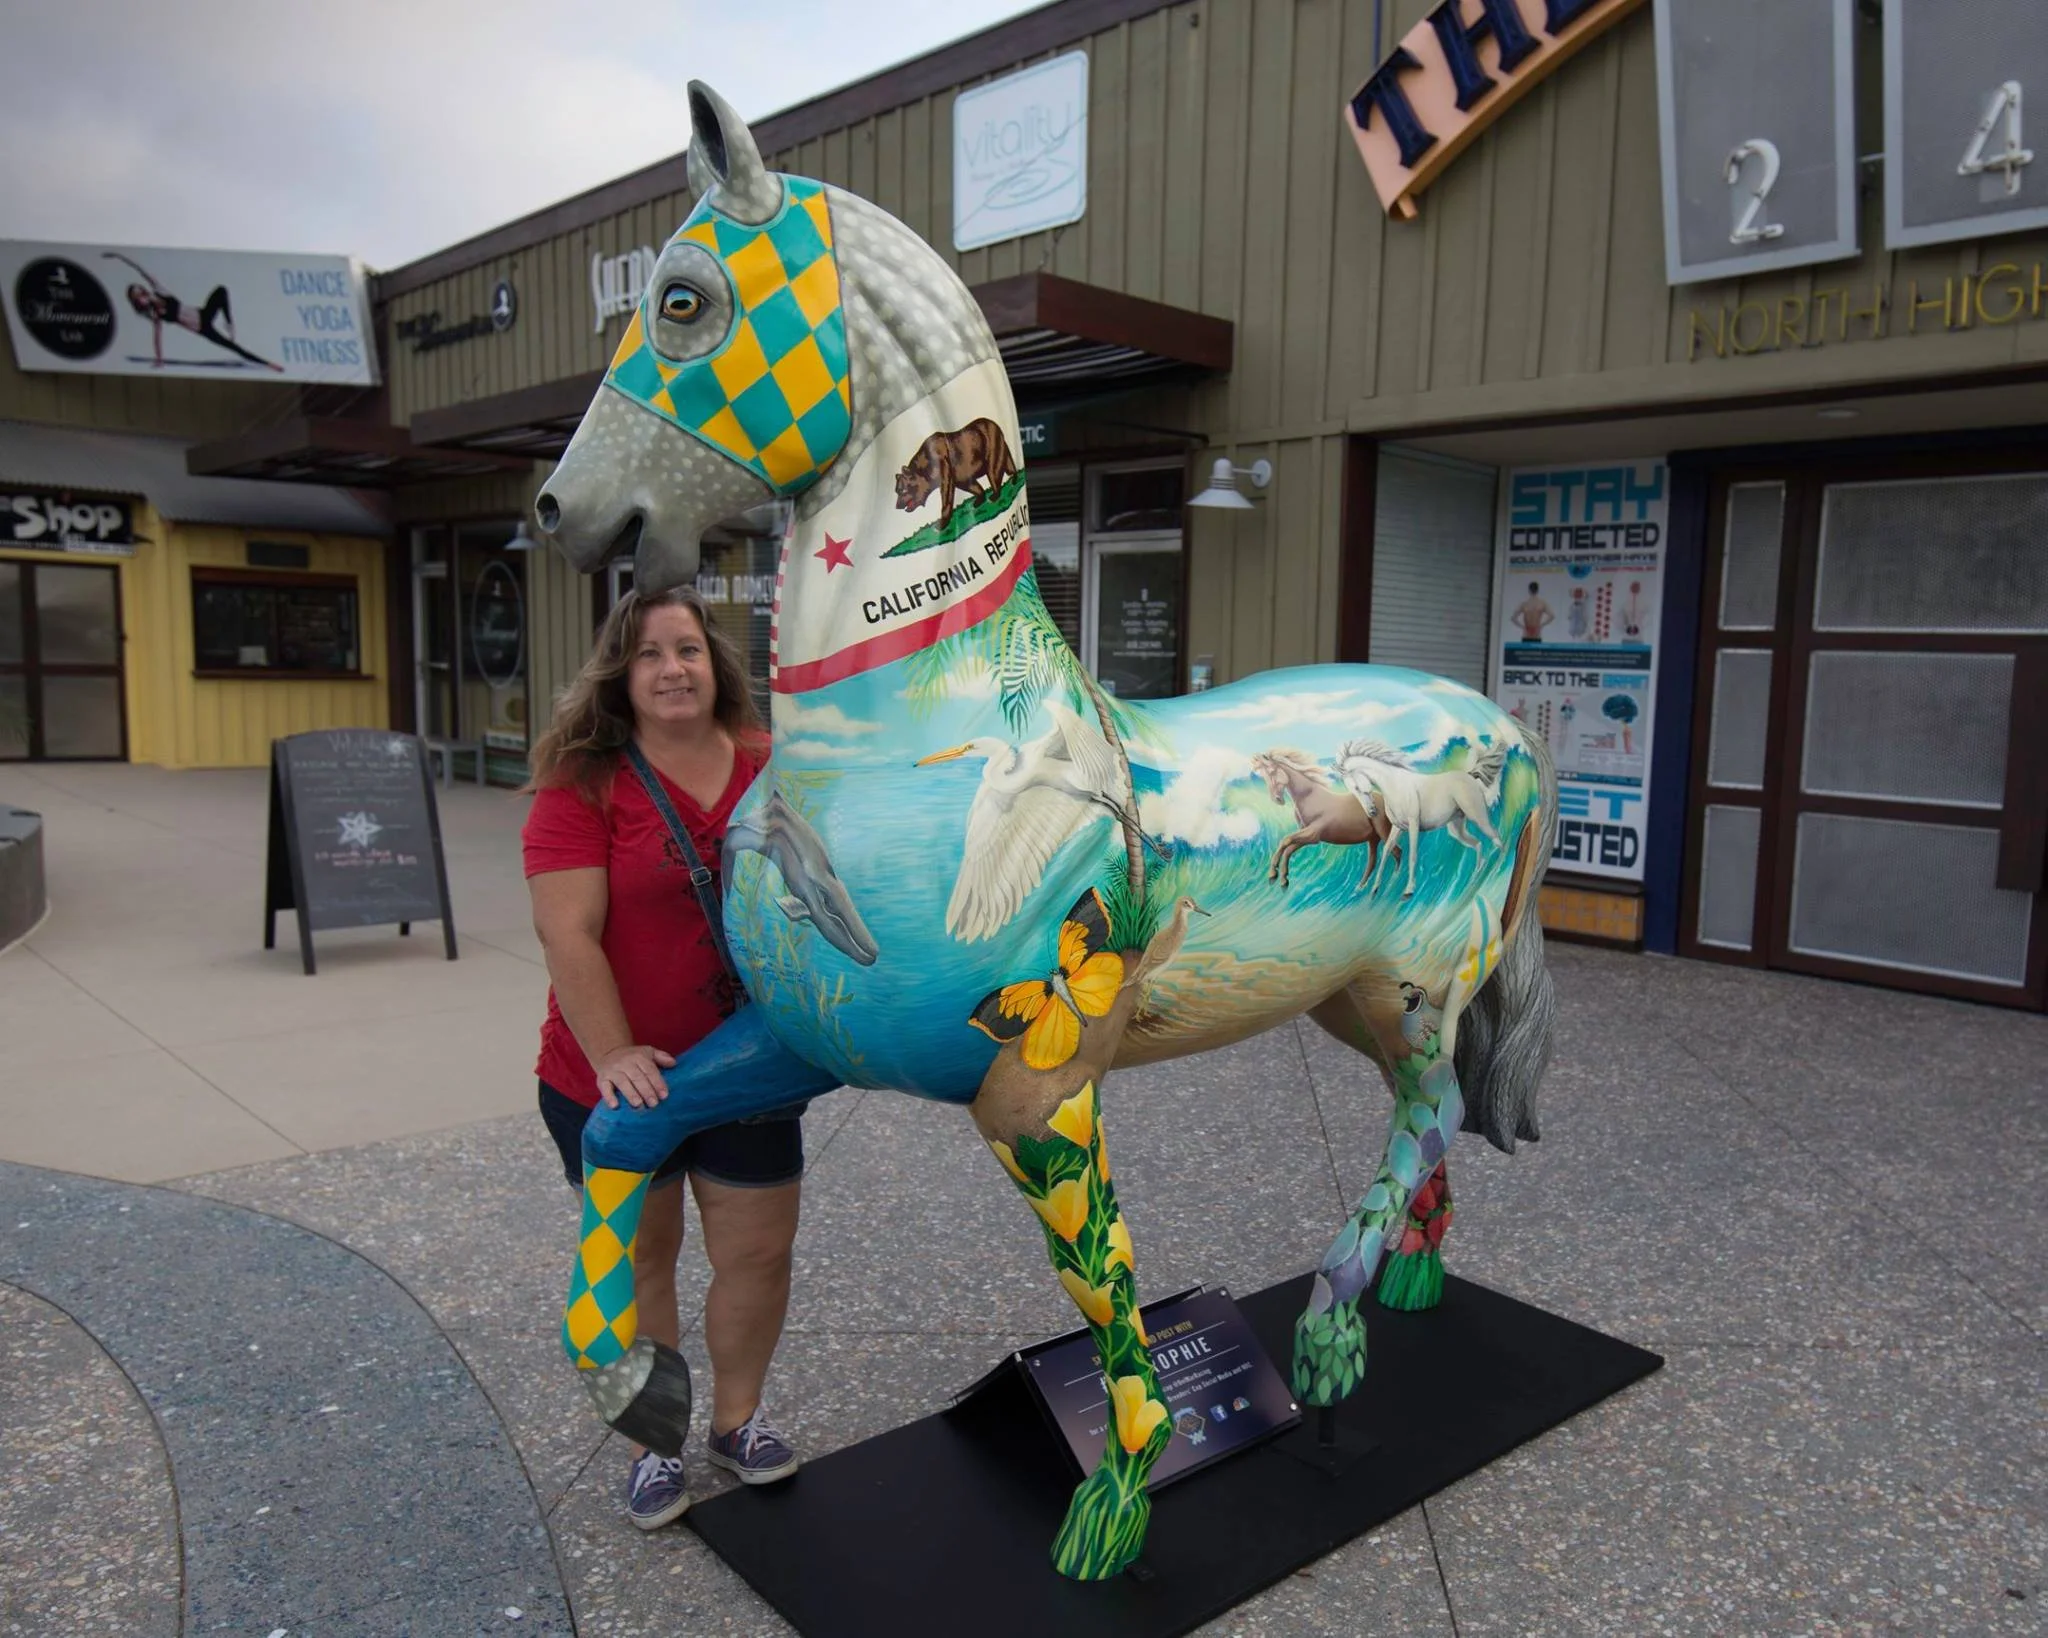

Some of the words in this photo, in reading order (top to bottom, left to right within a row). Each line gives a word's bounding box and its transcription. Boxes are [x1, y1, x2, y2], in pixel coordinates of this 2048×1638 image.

[1956, 80, 2035, 196] 4
[1722, 138, 1785, 245] 2
[280, 269, 347, 297] DANCE
[298, 305, 355, 331] YOGA
[1688, 283, 1883, 363] NORTH
[281, 337, 361, 366] FITNESS
[1511, 464, 1665, 526] STAY
[11, 496, 124, 540] Shop
[1509, 522, 1661, 551] CONNECTED
[862, 557, 984, 624] CALIFORNIA
[1503, 670, 1542, 686] BACK
[1546, 672, 1567, 686] TO
[1569, 671, 1600, 688] THE
